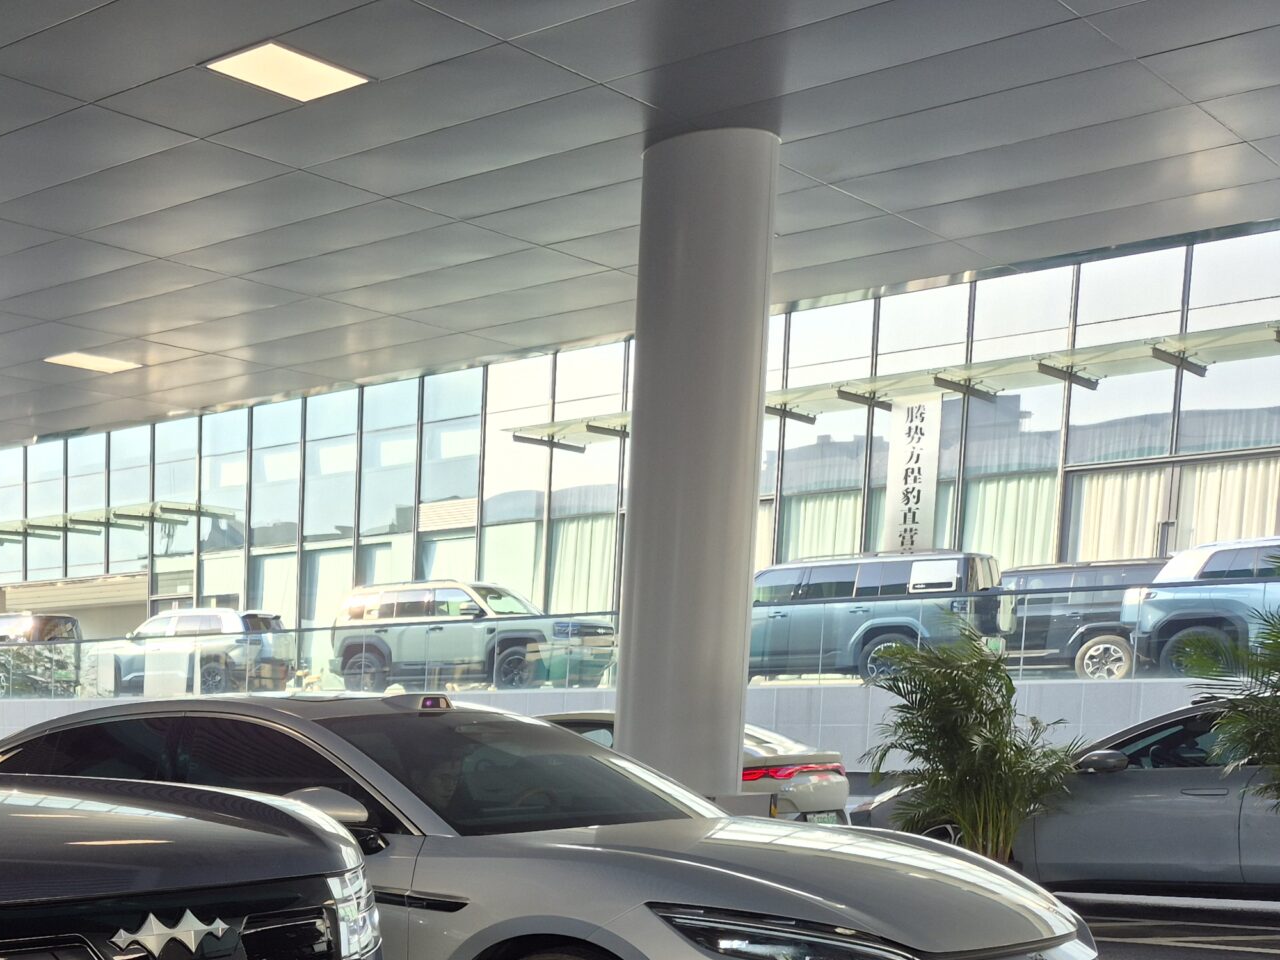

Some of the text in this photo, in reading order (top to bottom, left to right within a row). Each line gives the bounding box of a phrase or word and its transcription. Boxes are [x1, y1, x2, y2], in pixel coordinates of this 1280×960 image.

[898, 403, 926, 555] 腾势方程豹直营
